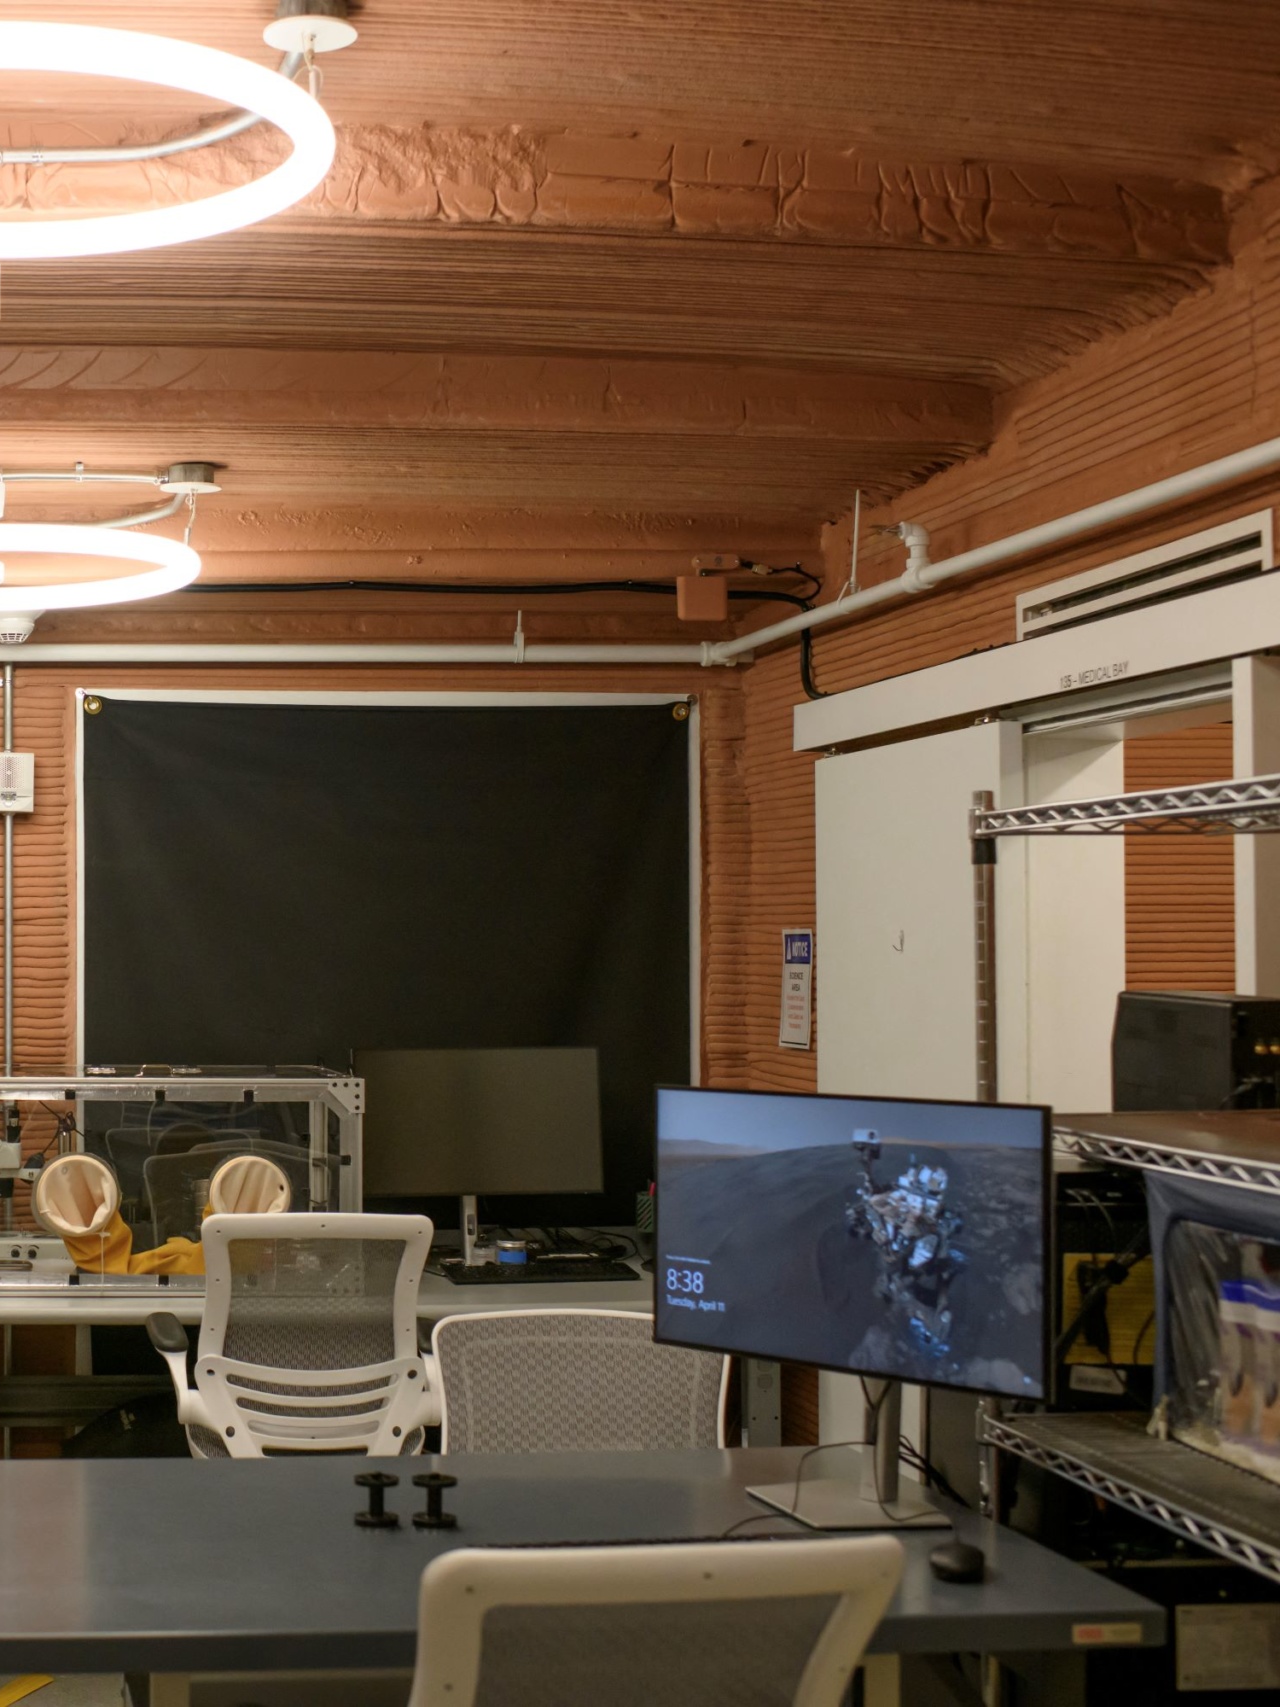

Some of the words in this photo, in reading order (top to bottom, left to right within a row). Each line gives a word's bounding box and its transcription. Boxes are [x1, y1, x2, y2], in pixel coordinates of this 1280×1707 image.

[1060, 674, 1072, 689] 135
[1078, 666, 1111, 685] MEDICAL
[1112, 660, 1129, 677] BAY
[791, 941, 808, 957] NOTICE
[666, 1268, 704, 1294] 8:38
[698, 1300, 716, 1311] April
